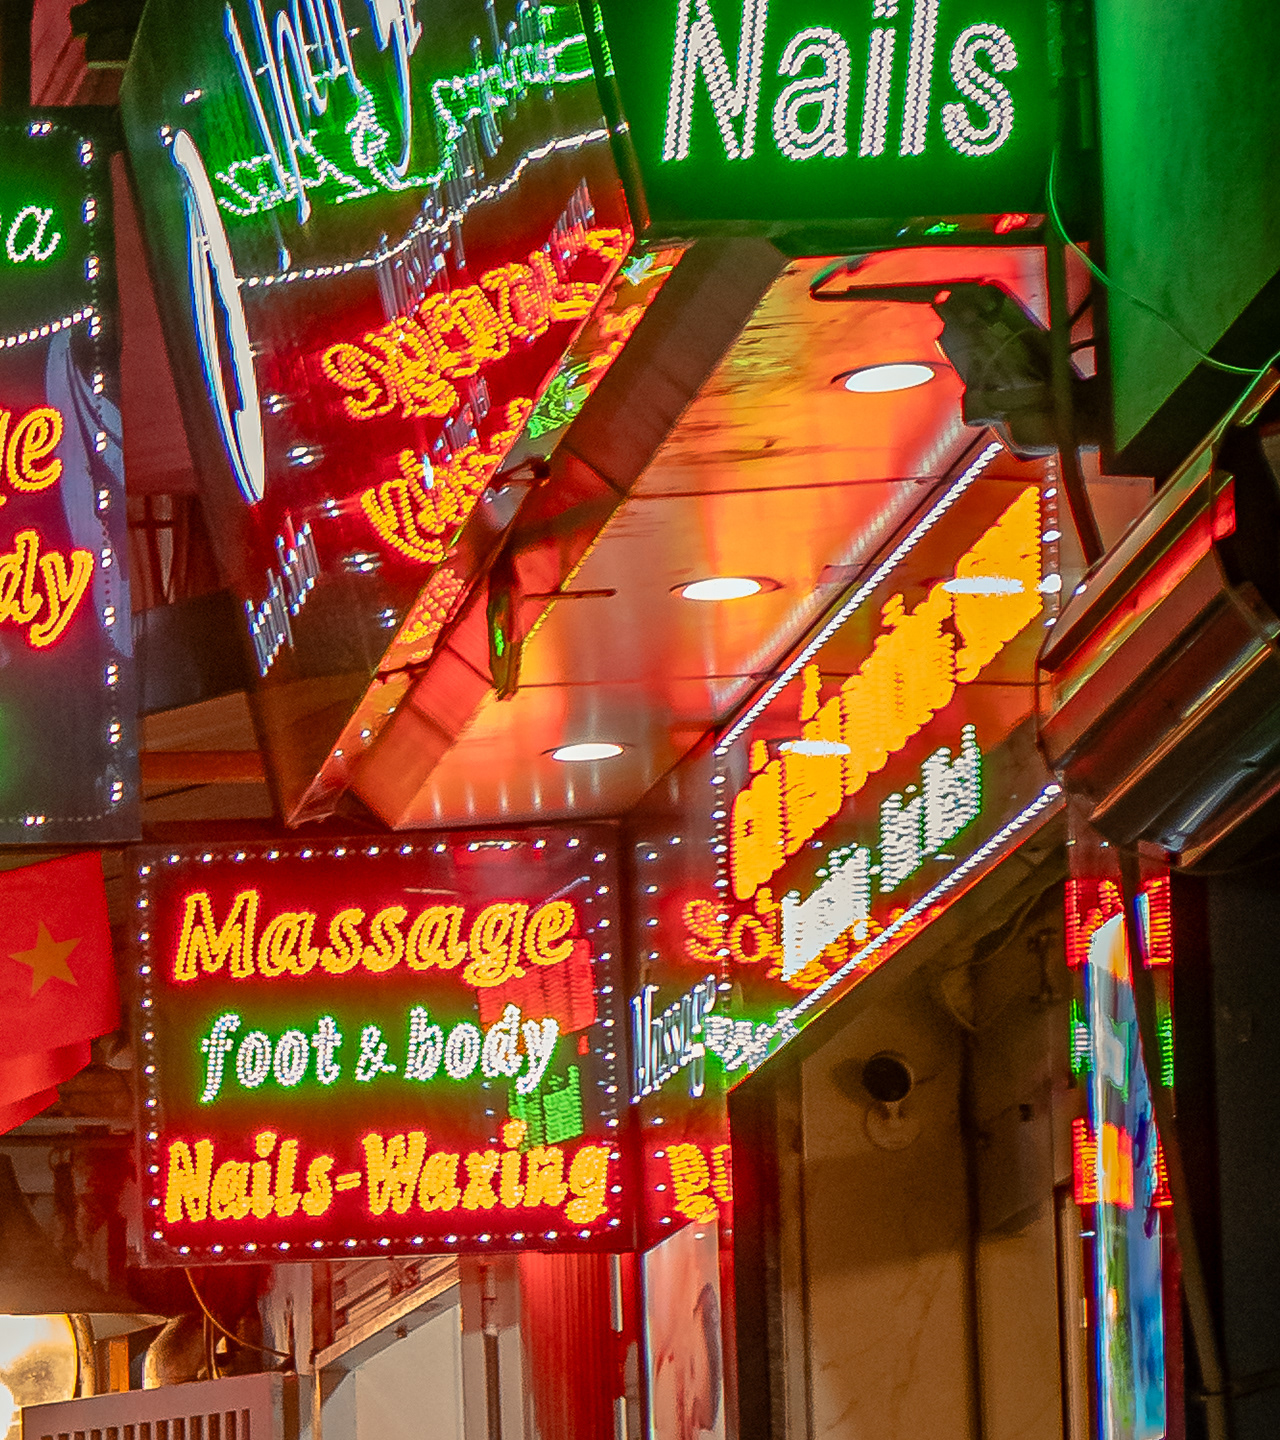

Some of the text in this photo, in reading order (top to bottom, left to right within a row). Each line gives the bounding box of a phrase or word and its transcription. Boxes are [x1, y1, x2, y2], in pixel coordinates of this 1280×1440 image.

[174, 890, 574, 987] Massage
[200, 1006, 558, 1103] foot & body
[164, 1119, 610, 1224] Nails-Waxing
